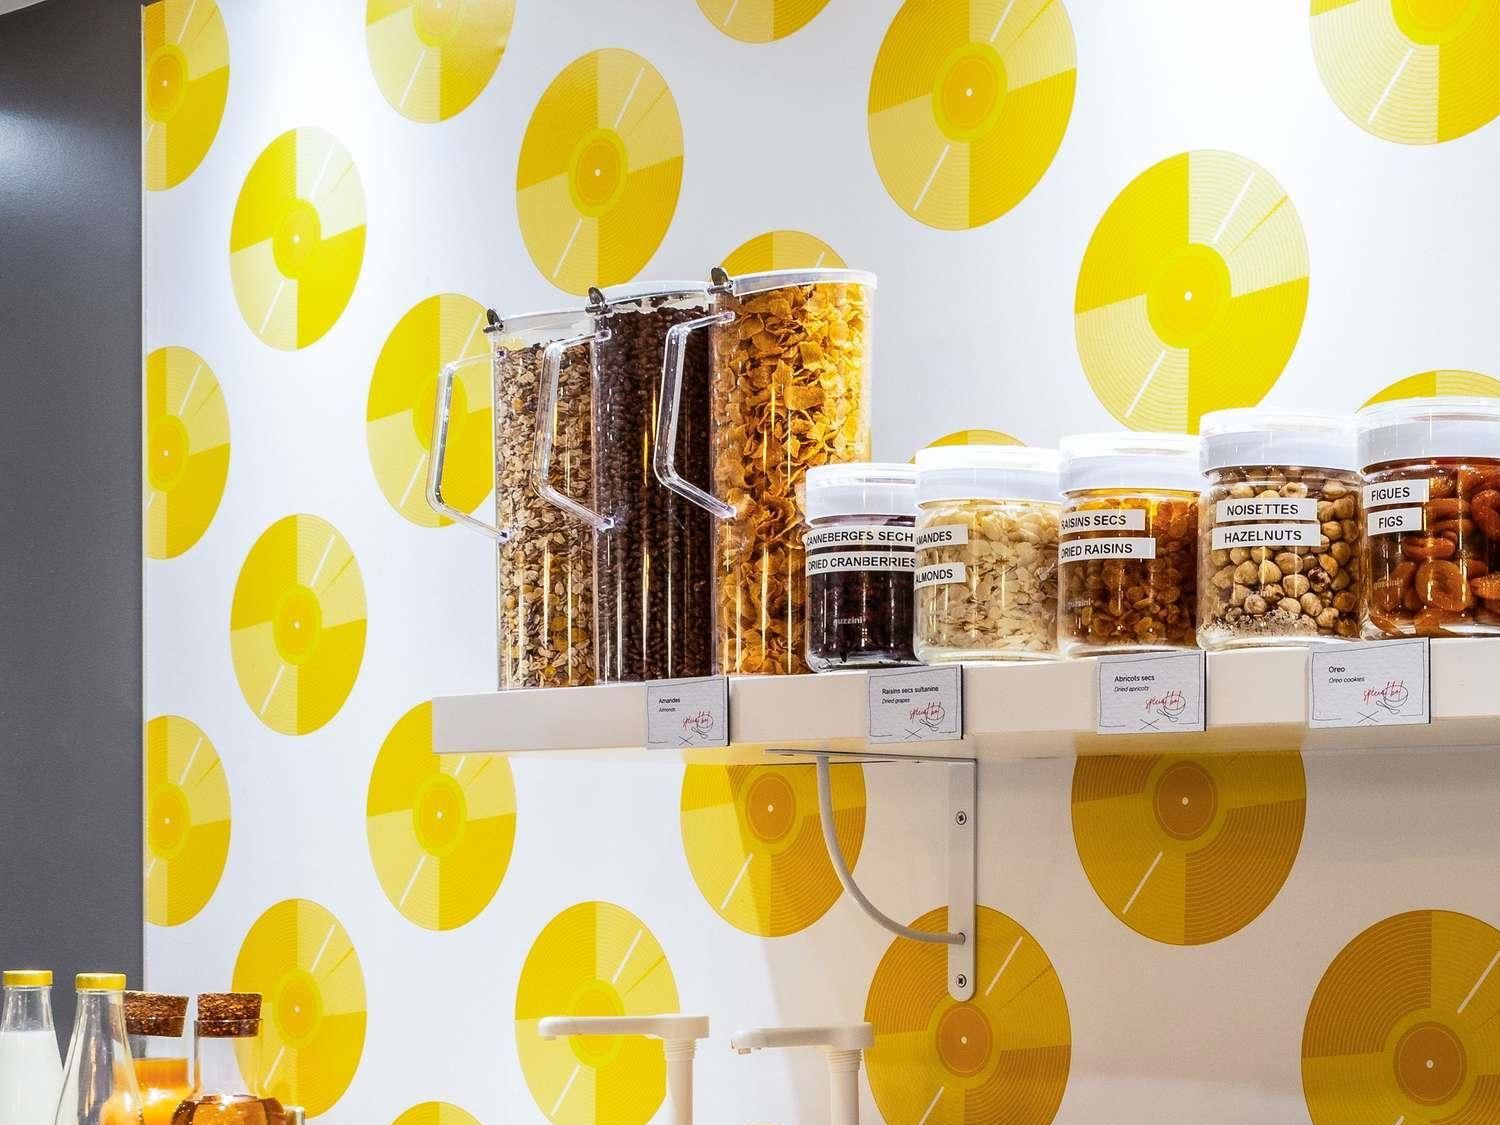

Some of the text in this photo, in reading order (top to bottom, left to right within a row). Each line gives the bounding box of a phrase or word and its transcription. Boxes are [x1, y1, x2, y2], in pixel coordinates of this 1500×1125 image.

[1371, 486, 1410, 501] FIGUES
[1226, 503, 1299, 516] NOISETTES
[1093, 514, 1127, 526] SECS
[1378, 515, 1403, 529] FIGS
[807, 530, 874, 546] CANNEBERGES
[1224, 529, 1302, 543] HAZELNUTS
[1084, 543, 1133, 556] RAISINS
[830, 556, 916, 569] CRANBERRIES
[1328, 665, 1346, 674] Oreo
[1114, 675, 1140, 683] Abricots
